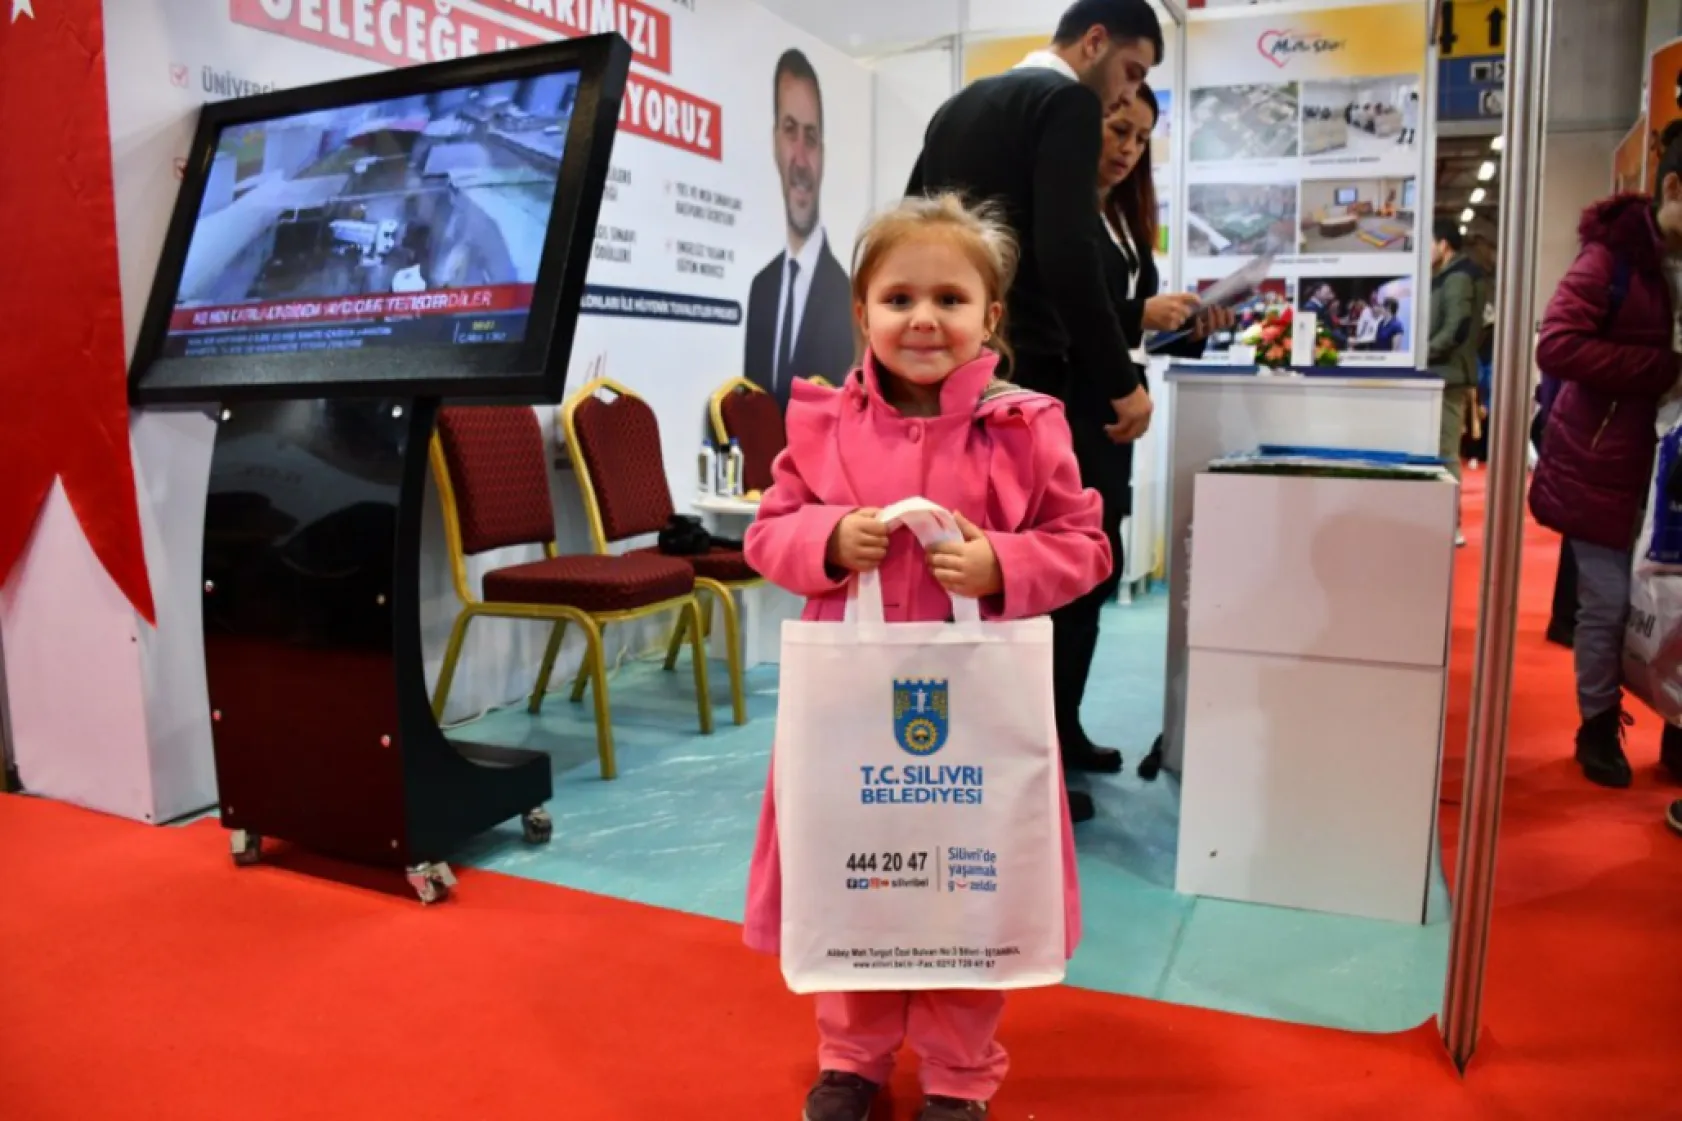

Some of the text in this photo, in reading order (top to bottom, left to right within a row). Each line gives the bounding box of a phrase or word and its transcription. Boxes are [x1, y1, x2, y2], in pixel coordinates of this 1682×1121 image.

[860, 765, 900, 785] T.C.
[846, 852, 928, 872] 444 20 47
[948, 864, 997, 877] yaşamak
